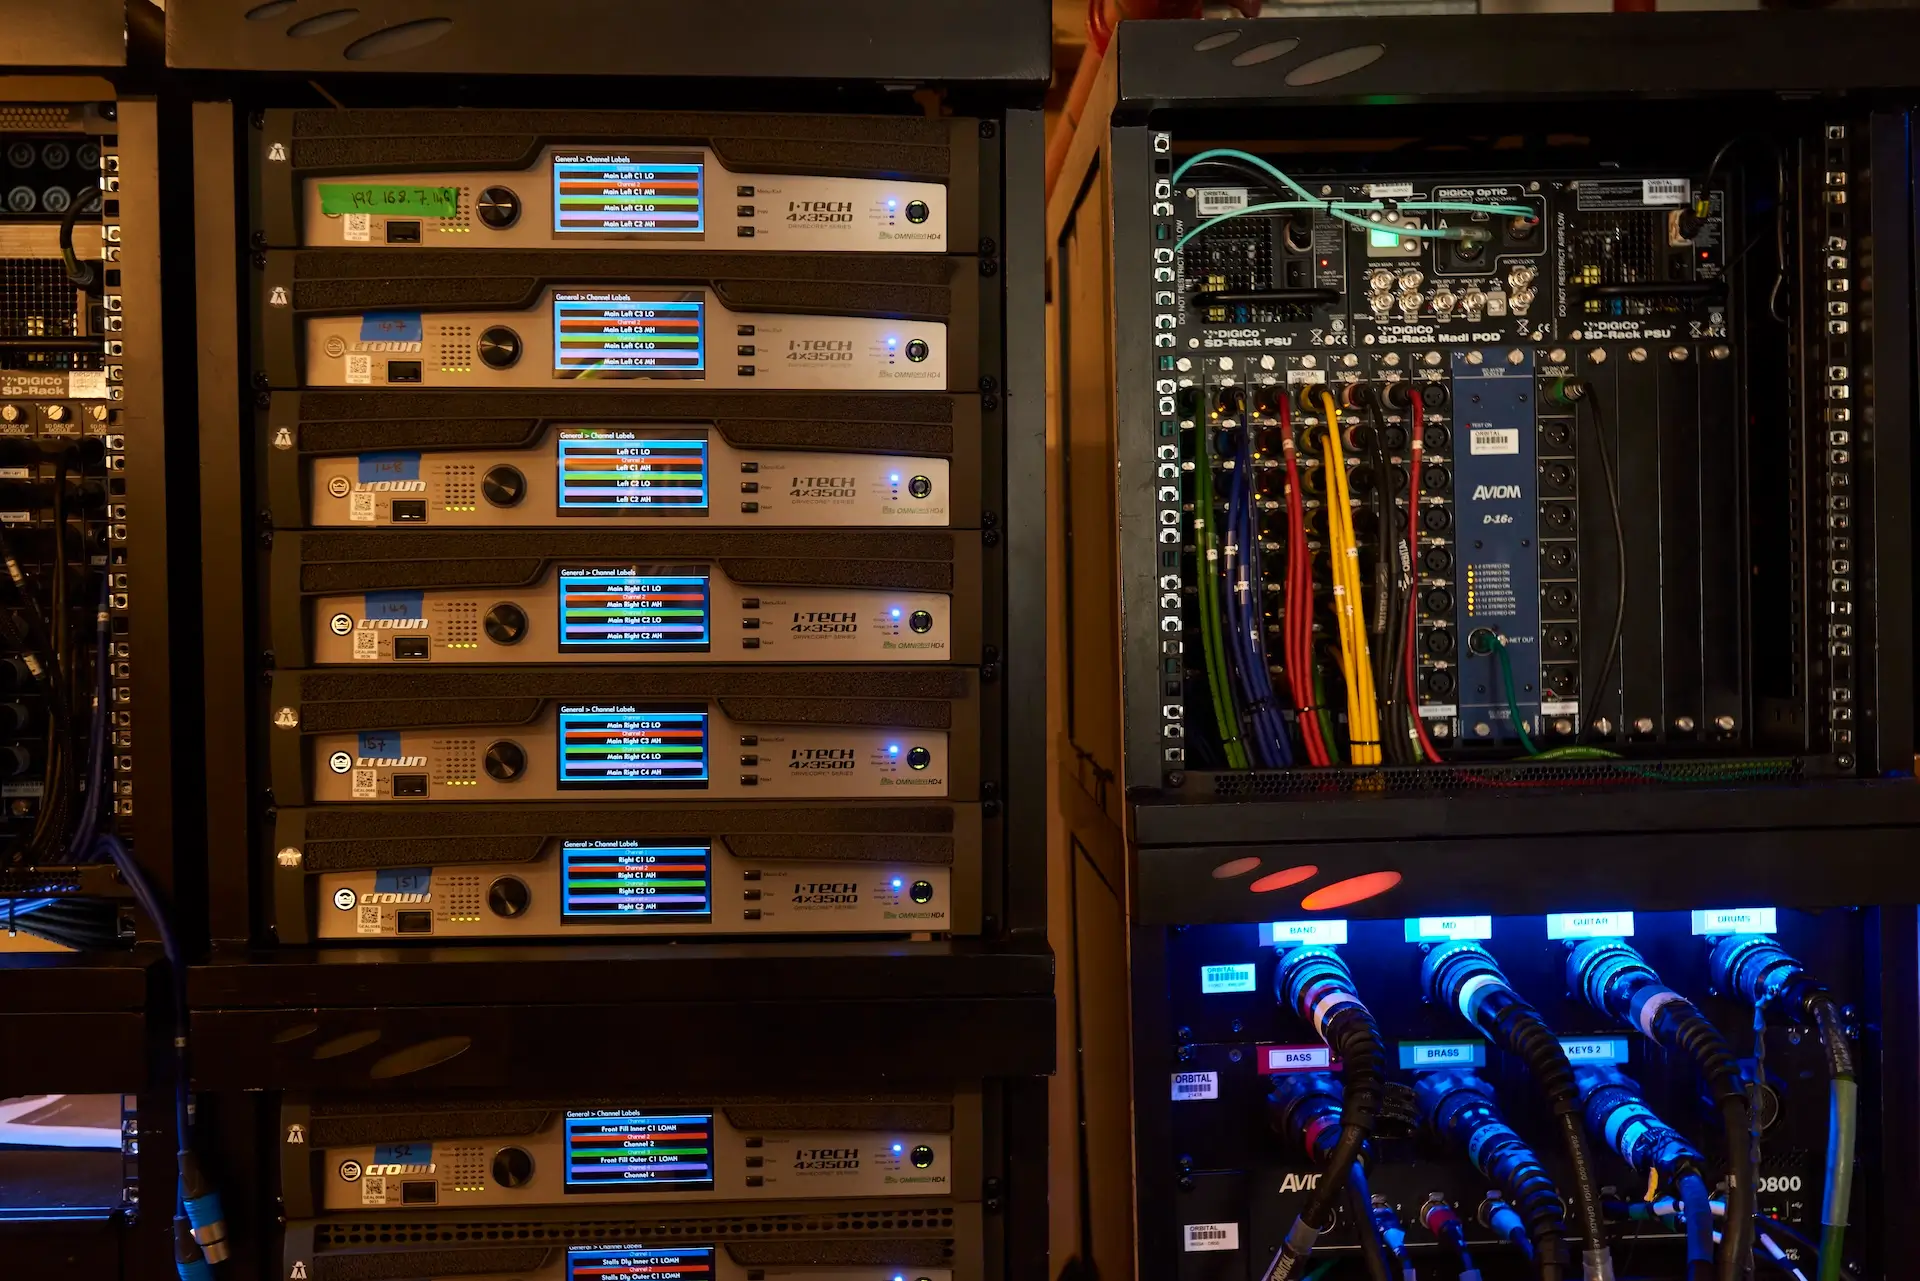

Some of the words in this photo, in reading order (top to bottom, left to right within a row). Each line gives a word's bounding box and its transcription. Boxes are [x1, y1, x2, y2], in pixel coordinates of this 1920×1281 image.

[1378, 335, 1435, 344] SD-Rack
[1439, 334, 1469, 342] Madi
[1473, 333, 1500, 341] POD
[1584, 331, 1642, 339] SD-Rack
[1645, 330, 1670, 338] PSU
[1204, 338, 1262, 347] SD-Rack
[1265, 337, 1292, 346] PSU
[1472, 485, 1521, 500] AVIOM
[364, 738, 386, 752] 157
[395, 876, 418, 890] 151
[1573, 918, 1609, 926] GUITAR
[1717, 915, 1750, 923] DRUMS
[1290, 925, 1316, 934] BAND
[1427, 1048, 1459, 1058] BRASS
[1568, 1046, 1593, 1055] KEYS
[1595, 1045, 1601, 1054] 2
[1286, 1053, 1312, 1063] BASS
[1175, 1073, 1212, 1084] ORBITAL
[1279, 1173, 1322, 1193] AVI
[1586, 1205, 1598, 1233] GRADE
